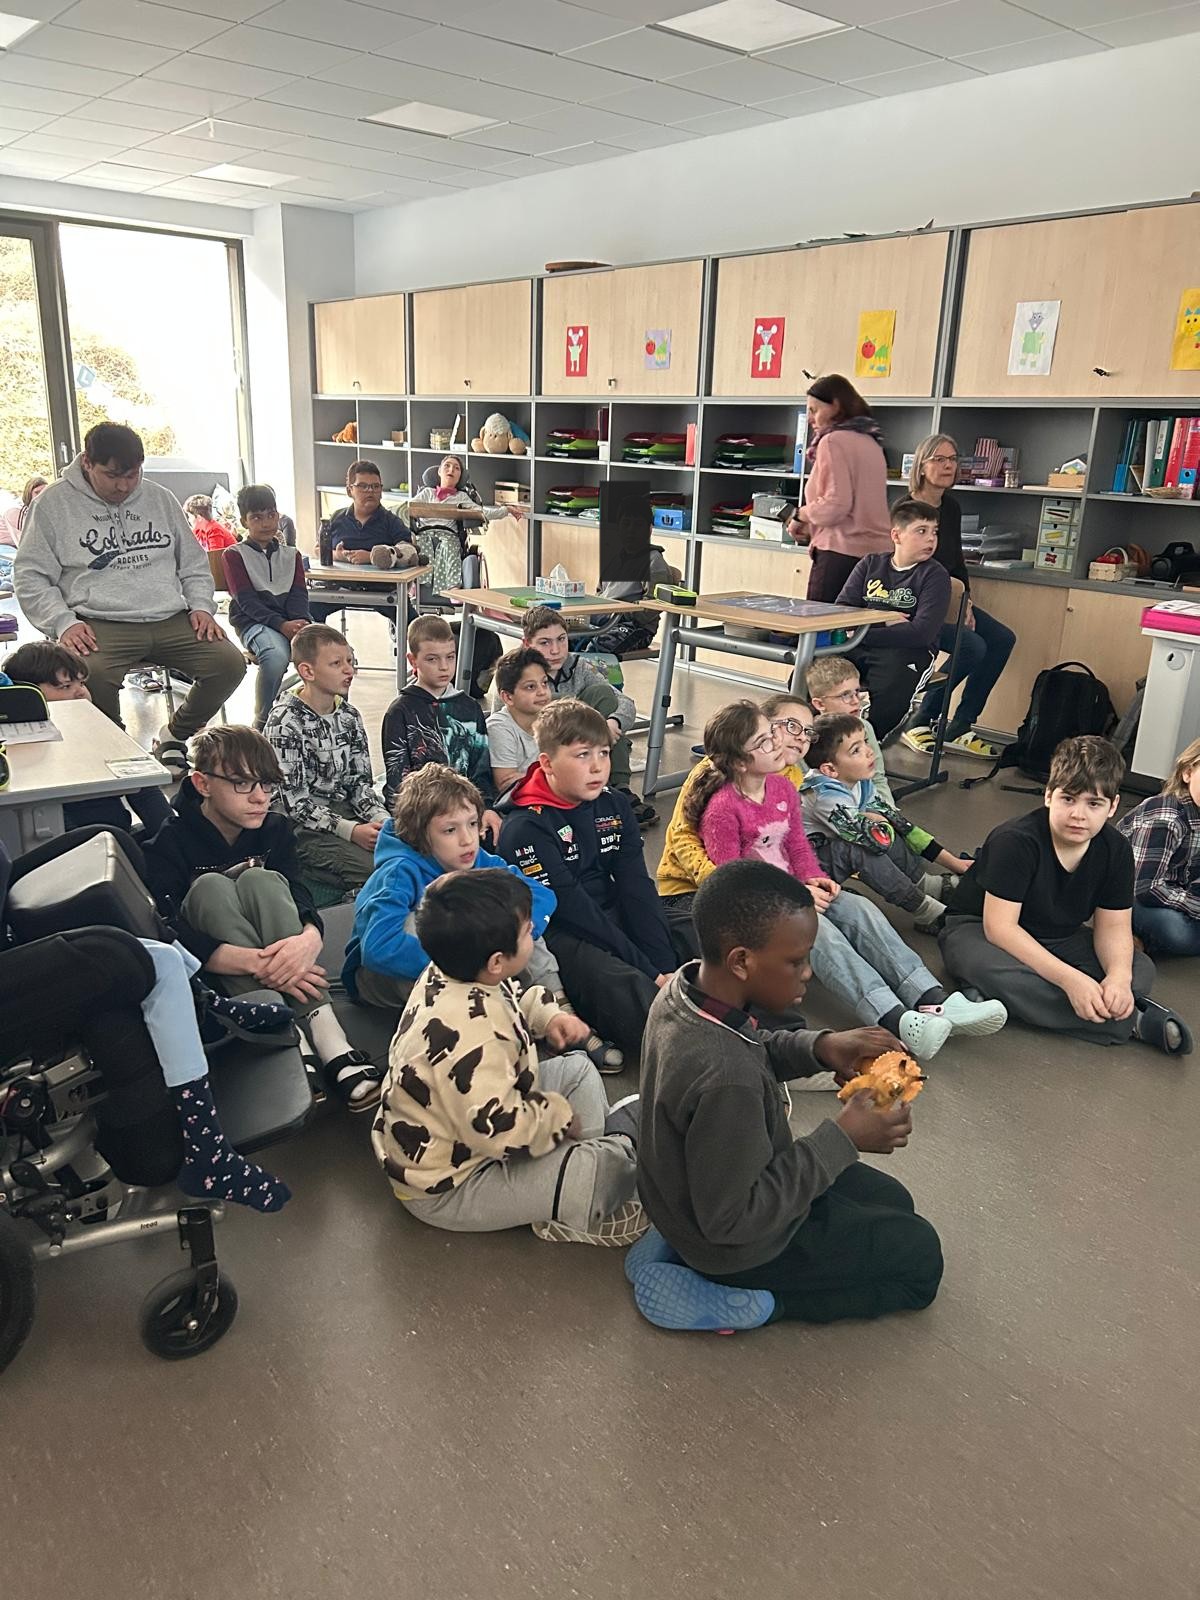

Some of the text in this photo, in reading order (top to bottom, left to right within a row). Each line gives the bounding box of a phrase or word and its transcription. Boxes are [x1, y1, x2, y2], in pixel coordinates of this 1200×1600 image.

[80, 521, 168, 556] Colrado
[117, 554, 149, 564] ROCKIES
[601, 833, 621, 845] BYBIT
[515, 845, 535, 857] Mobil
